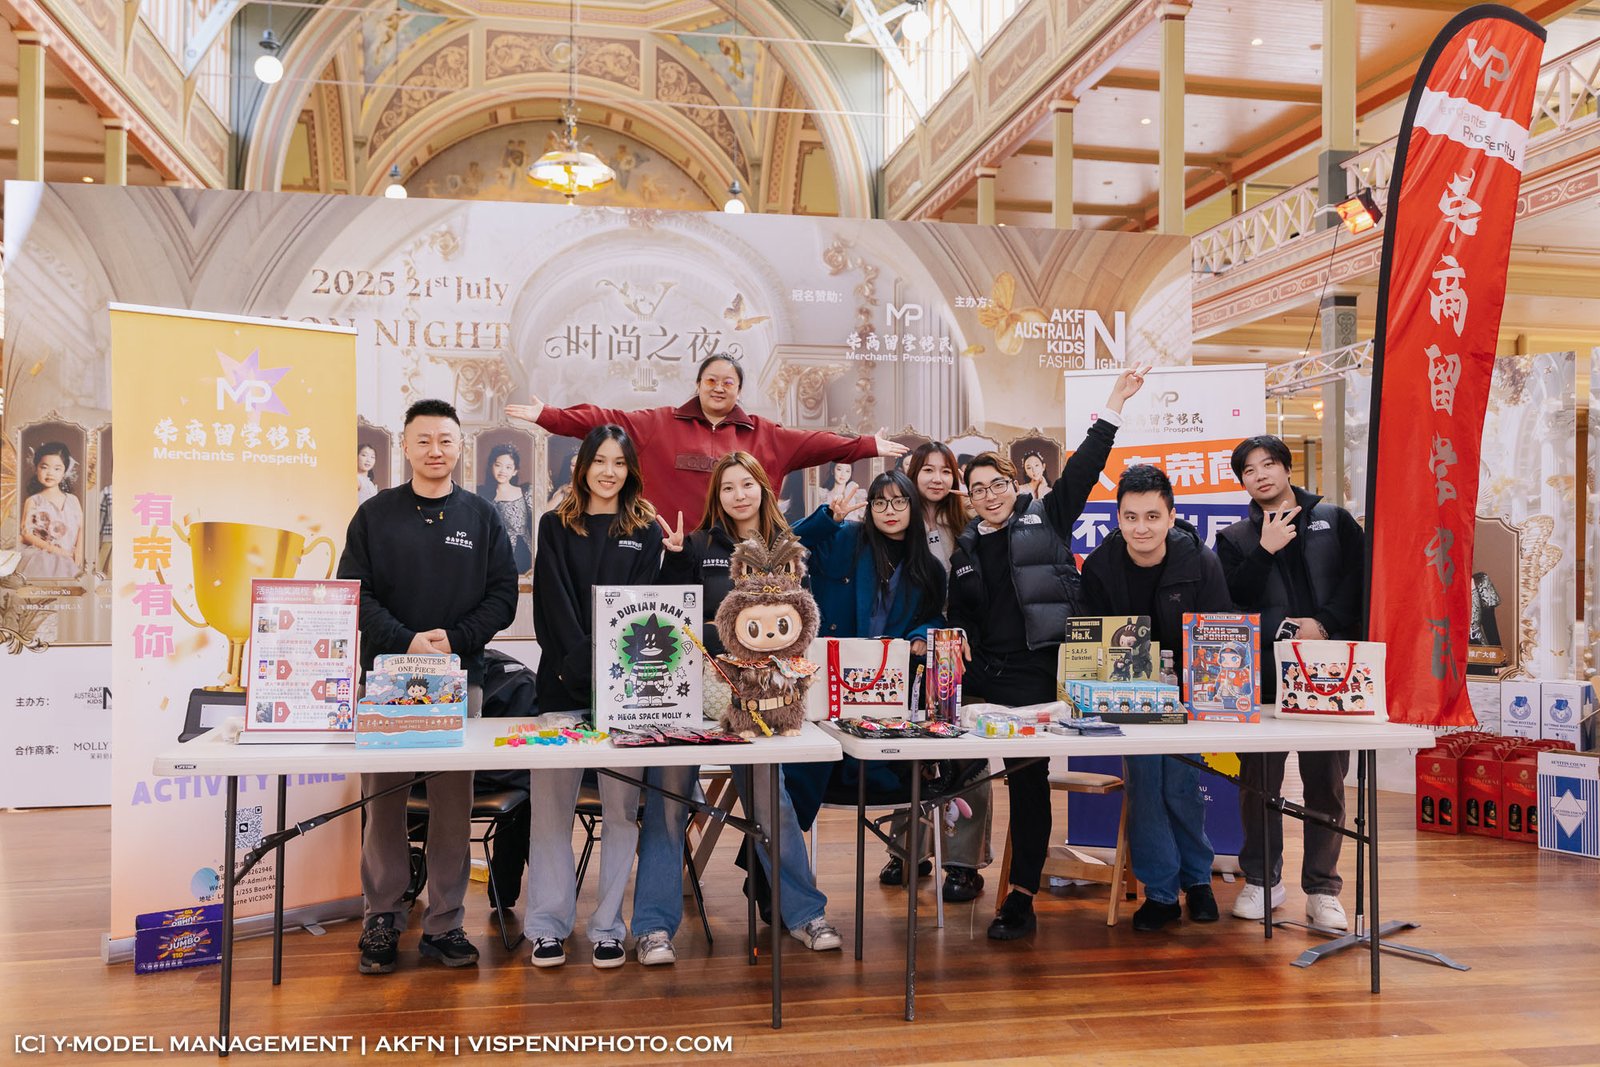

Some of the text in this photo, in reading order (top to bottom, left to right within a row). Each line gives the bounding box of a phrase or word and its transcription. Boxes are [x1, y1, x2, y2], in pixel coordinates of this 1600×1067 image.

[1463, 126, 1516, 161] Proserity
[311, 268, 509, 306] 2025 21st July
[886, 303, 923, 327] MP
[1050, 308, 1085, 323] AKF
[375, 319, 512, 349] NIGHT
[1013, 322, 1084, 341] AUSTRALIA
[566, 323, 722, 363] 时尚之夜
[1047, 339, 1085, 354] KIDS
[846, 351, 954, 365] Merchants Prosperity
[216, 377, 272, 411] MP
[153, 447, 318, 467] Merchants Prosperity
[131, 492, 175, 659] 有荣有你
[617, 601, 684, 619] DURIAN MAN
[1071, 631, 1093, 640] Ma.K.
[1200, 633, 1247, 641] FORMERS
[319, 644, 326, 653] 2
[406, 656, 447, 665] MONSTERS
[279, 665, 286, 674] 3
[414, 666, 436, 674] PIECE
[317, 686, 324, 695] 4
[15, 696, 50, 707] 主办方:
[277, 707, 284, 716] 5
[638, 712, 660, 720] SPACE
[661, 711, 682, 719] MOLLY
[15, 744, 59, 756] 合作商家:
[74, 741, 109, 751] MOLLY
[131, 774, 267, 806] ACTIVTY
[248, 893, 273, 903] VIC3000
[168, 936, 201, 951] JUMBO
